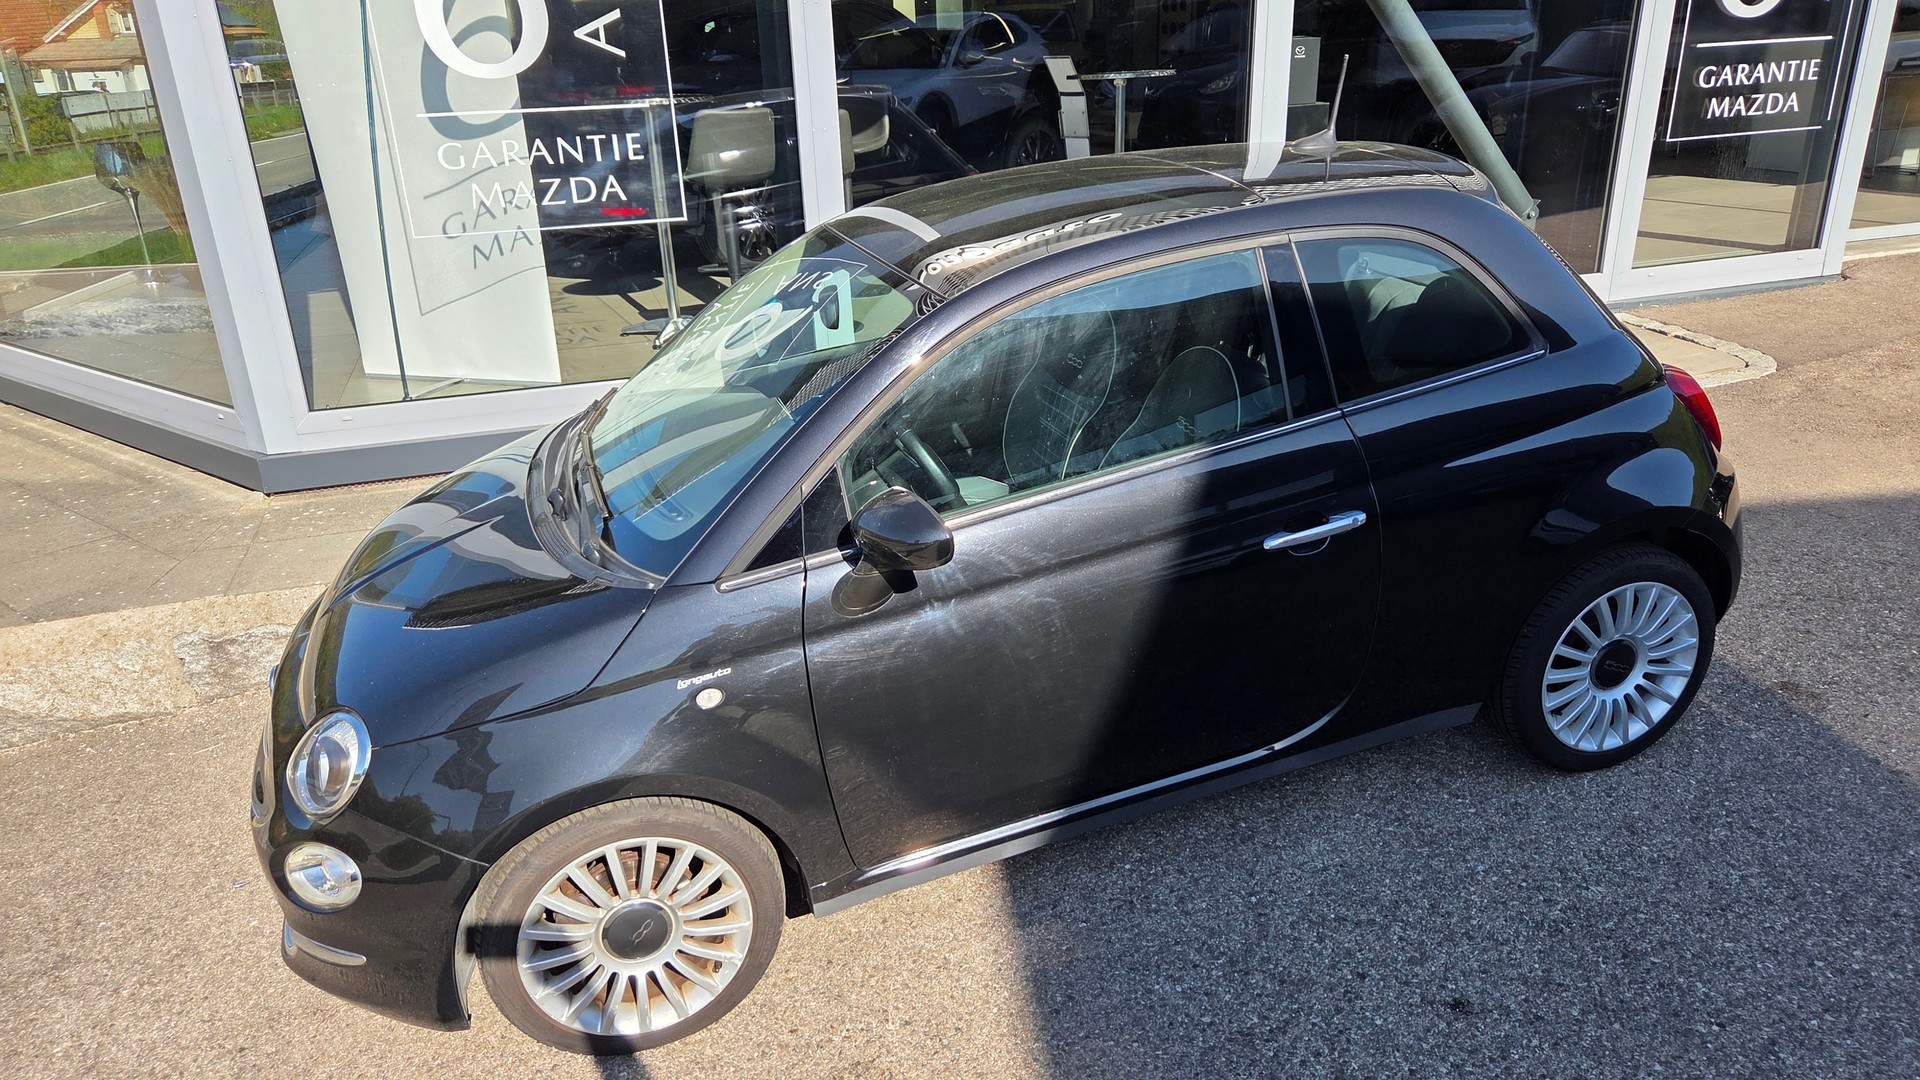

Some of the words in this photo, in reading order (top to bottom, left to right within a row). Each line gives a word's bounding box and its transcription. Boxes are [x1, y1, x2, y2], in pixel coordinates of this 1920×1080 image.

[1698, 58, 1821, 88] GARANTIE
[1706, 91, 1799, 119] MAZDA
[437, 132, 644, 170] GARANTIE
[471, 174, 628, 210] MAZDA
